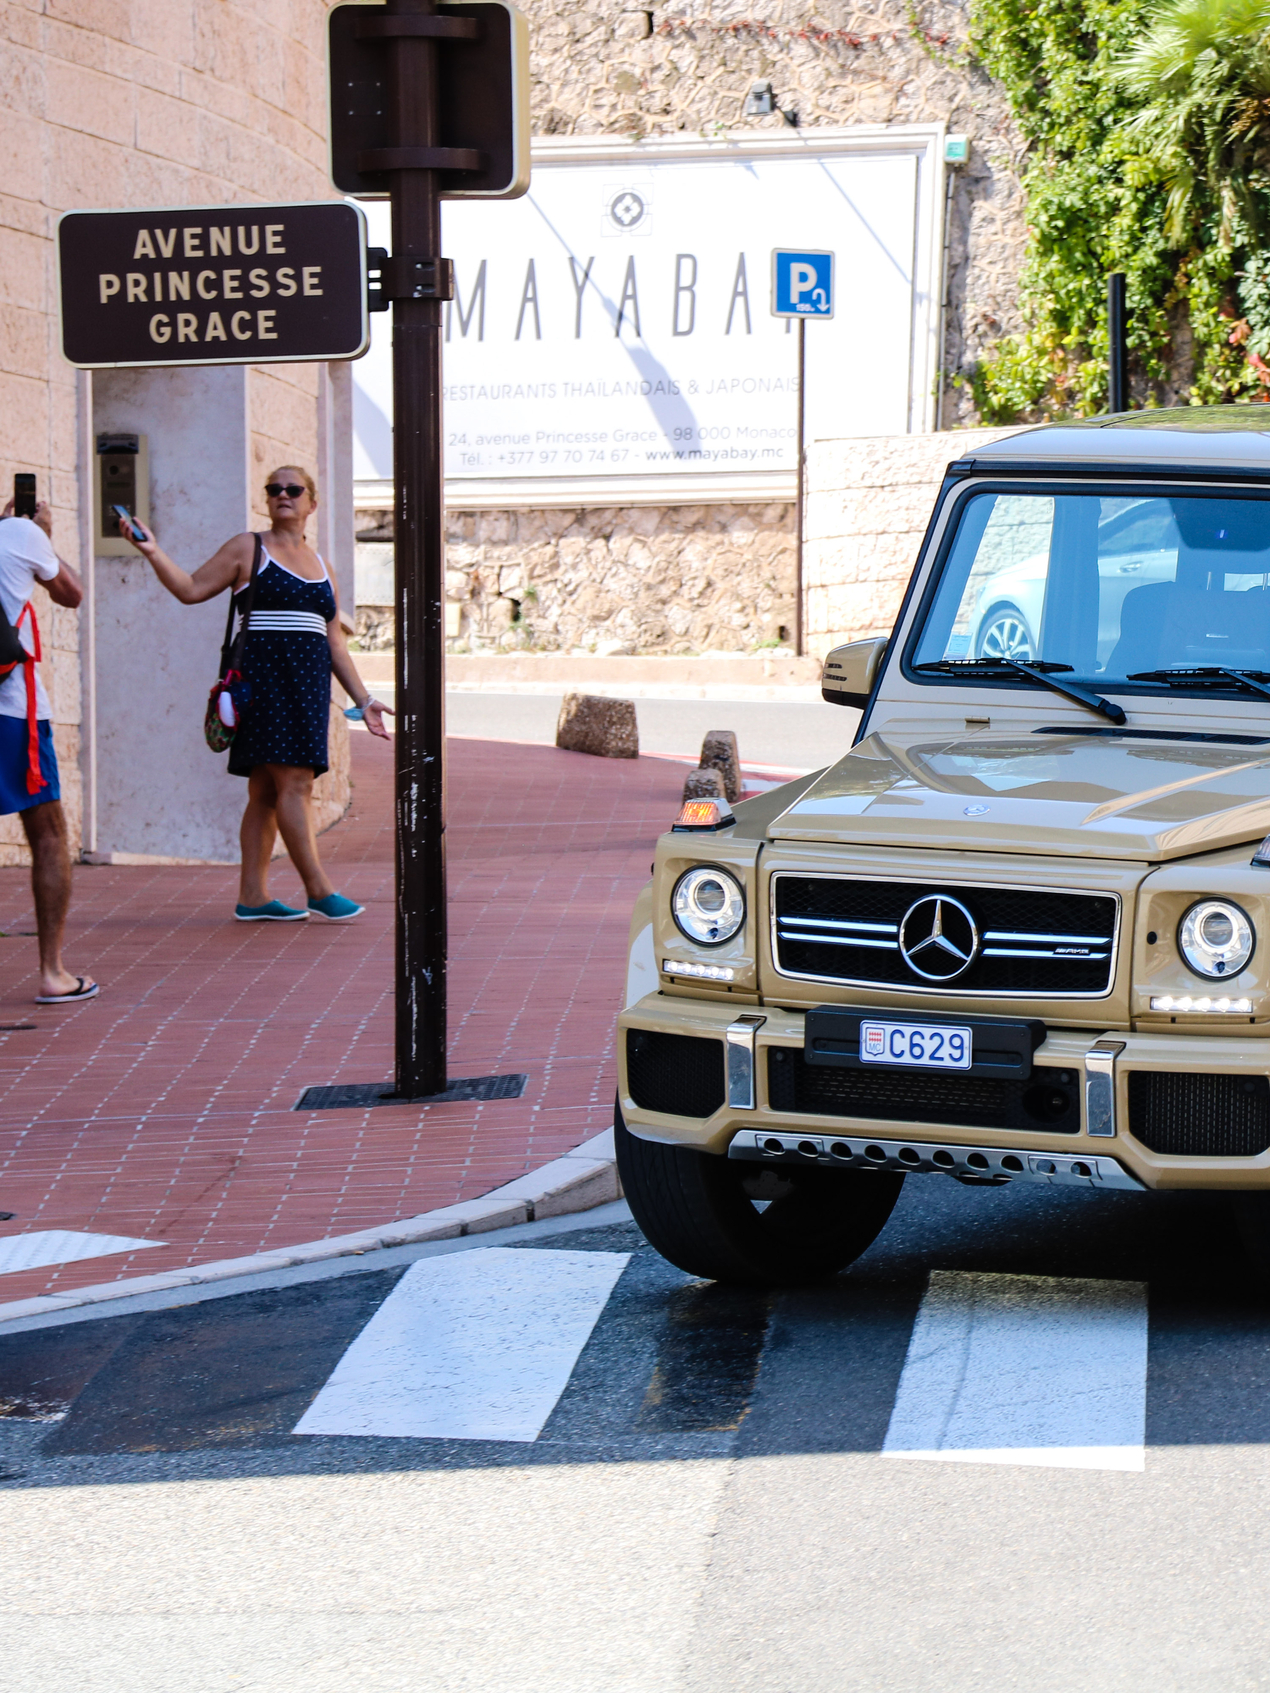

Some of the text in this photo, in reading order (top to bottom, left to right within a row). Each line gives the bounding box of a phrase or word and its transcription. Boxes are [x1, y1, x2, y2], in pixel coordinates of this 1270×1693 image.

[133, 224, 287, 259] AVENUE
[99, 266, 324, 304] PRINCESSE
[445, 251, 791, 342] MAYABA
[789, 261, 818, 304] P
[149, 309, 279, 344] GRACE
[563, 377, 681, 399] THAÏLANDAIS
[687, 379, 700, 395] &
[706, 376, 799, 395] JAPONAIS
[448, 433, 471, 448] 24,
[475, 434, 530, 446] avenue
[535, 430, 609, 444] Princesse
[612, 428, 658, 442] Grace
[672, 427, 693, 441] 98
[697, 426, 731, 440] 000
[736, 426, 798, 440] Monaco
[459, 451, 485, 466] Tél.
[497, 451, 535, 465] +377
[539, 450, 558, 464] 97
[563, 449, 583, 463] 70
[587, 449, 605, 463] 74
[610, 448, 629, 463] 67
[645, 446, 784, 462] www.mayabay.mc
[868, 1028, 965, 1063] MC C629
